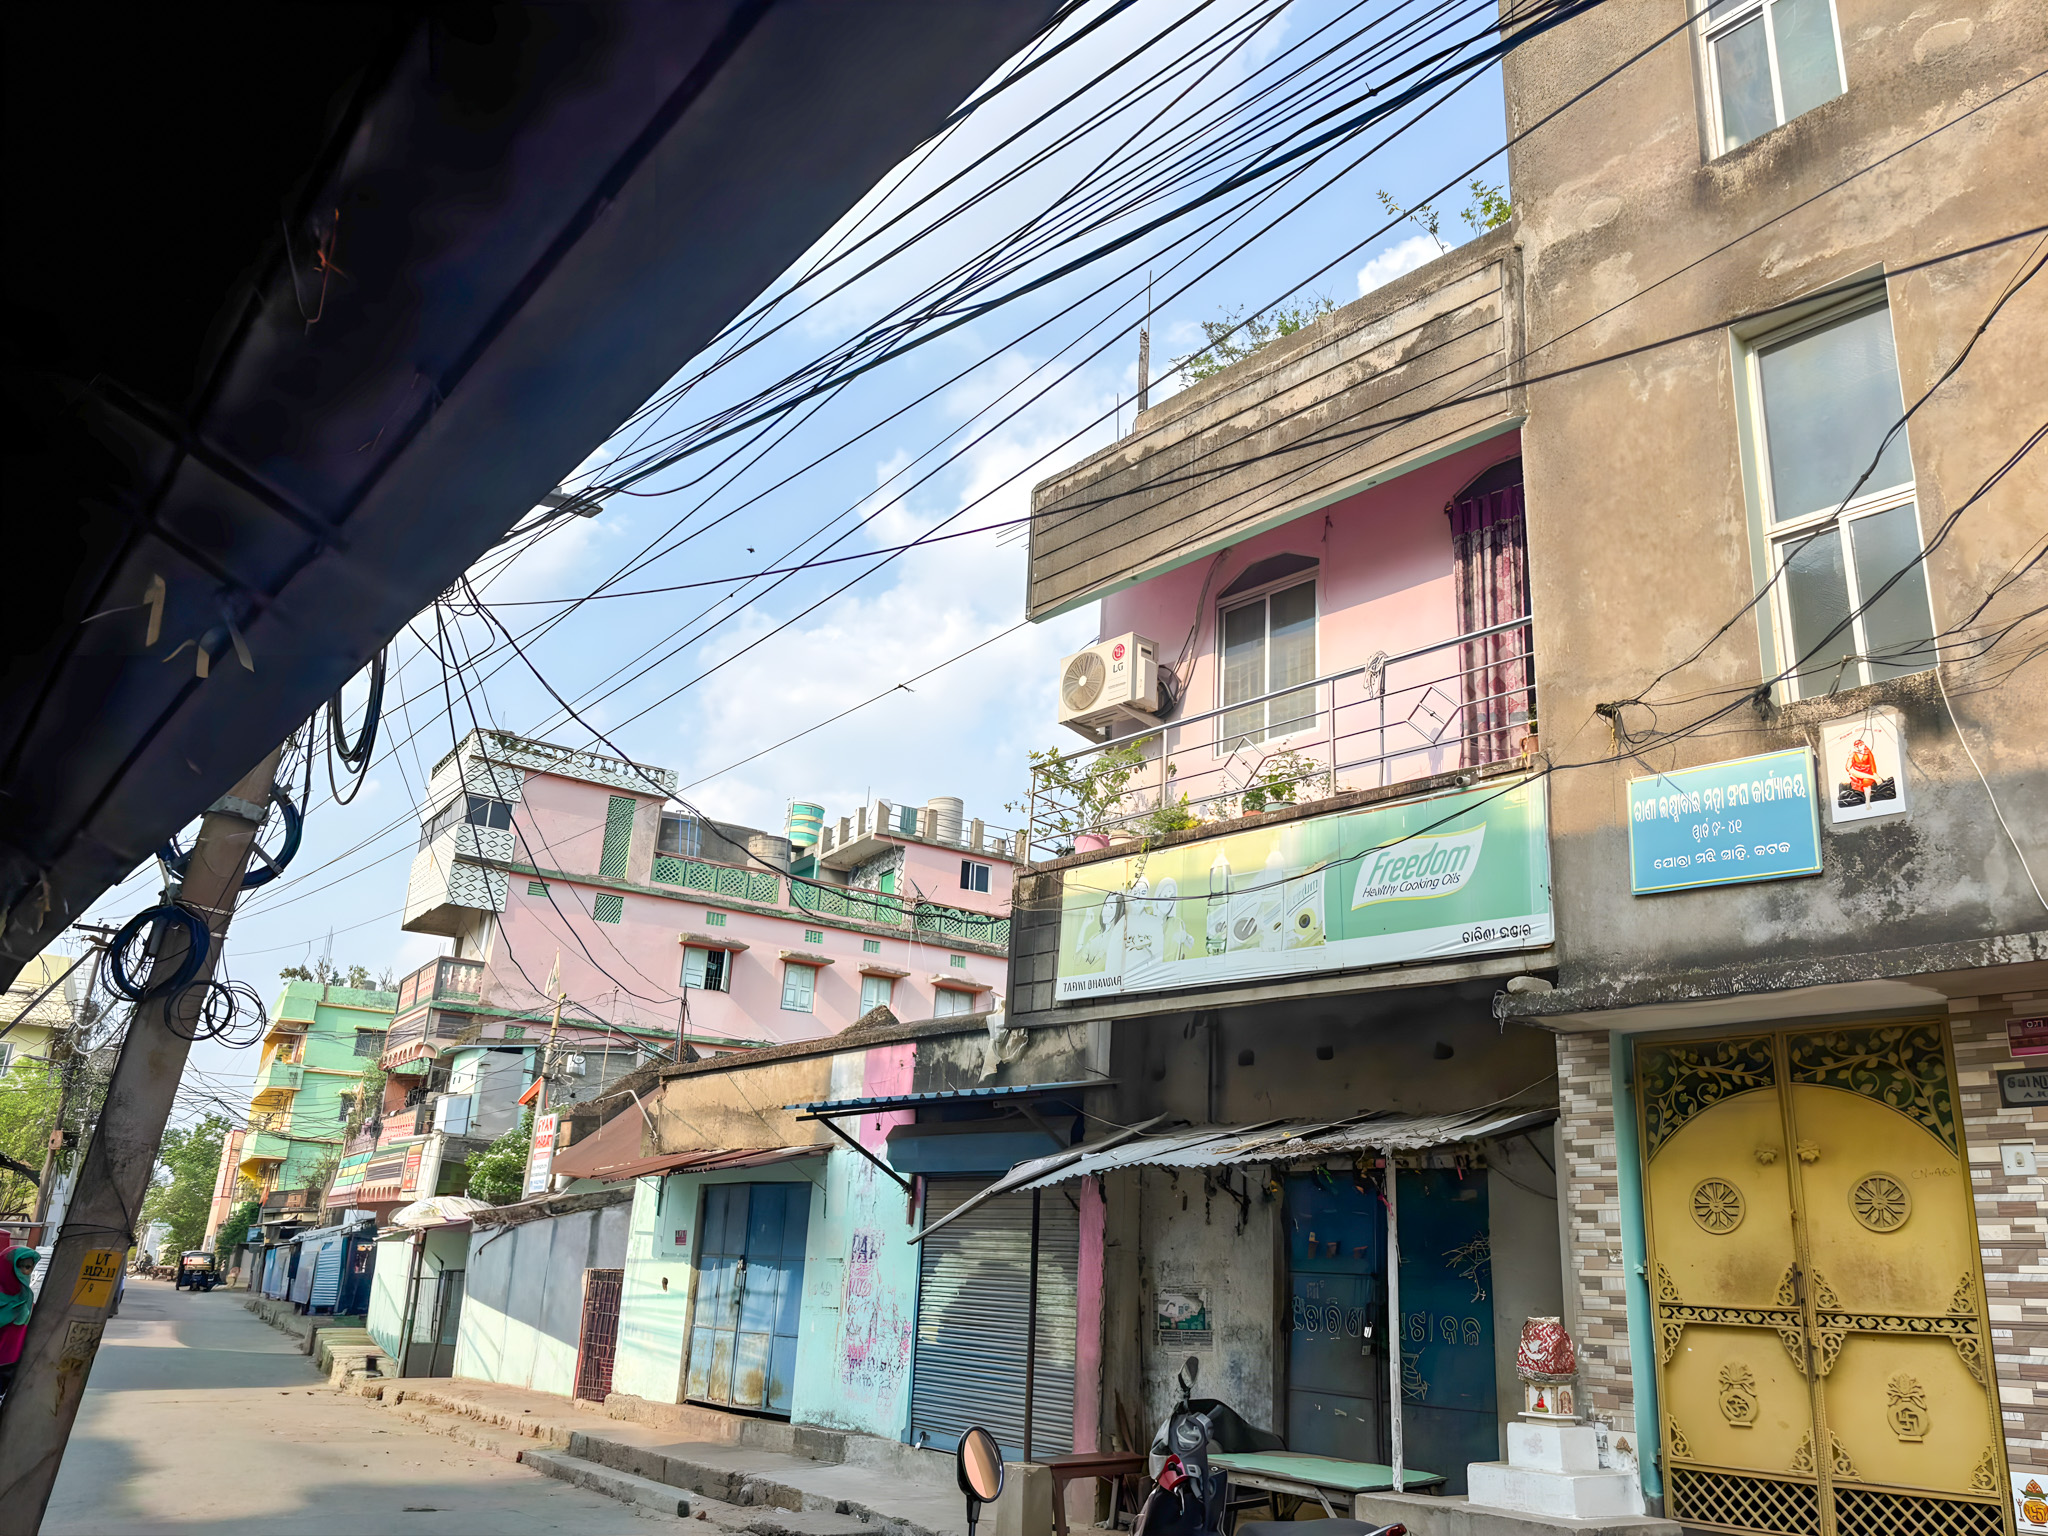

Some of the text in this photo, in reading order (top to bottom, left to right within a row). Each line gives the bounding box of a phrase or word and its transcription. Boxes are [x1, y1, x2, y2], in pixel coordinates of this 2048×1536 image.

[1112, 662, 1124, 674] LG
[1753, 841, 1791, 856] କଟକ
[1366, 842, 1471, 886] Freedom
[1362, 872, 1461, 898] Healthy Cooking Oils
